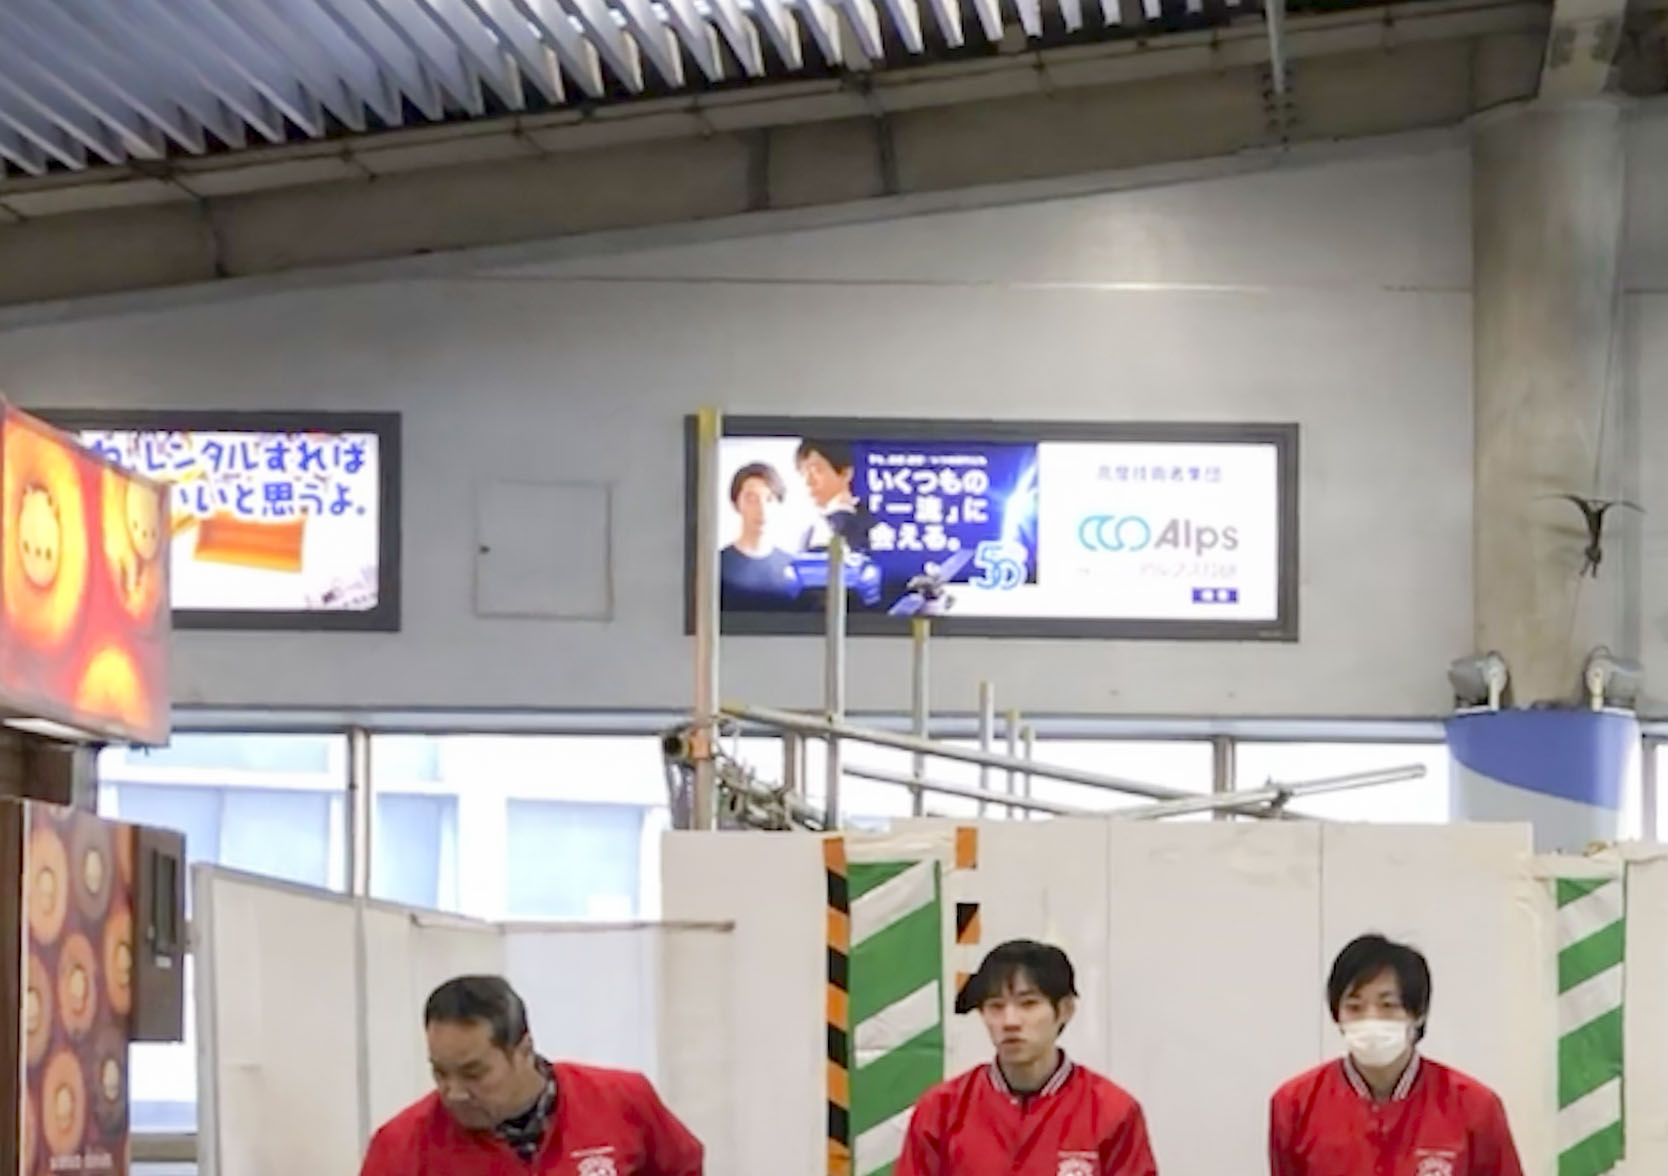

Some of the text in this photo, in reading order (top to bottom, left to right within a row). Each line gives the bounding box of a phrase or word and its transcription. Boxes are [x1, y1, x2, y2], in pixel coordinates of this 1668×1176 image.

[868, 468, 989, 495] いくつもの
[1154, 518, 1239, 556] Alps
